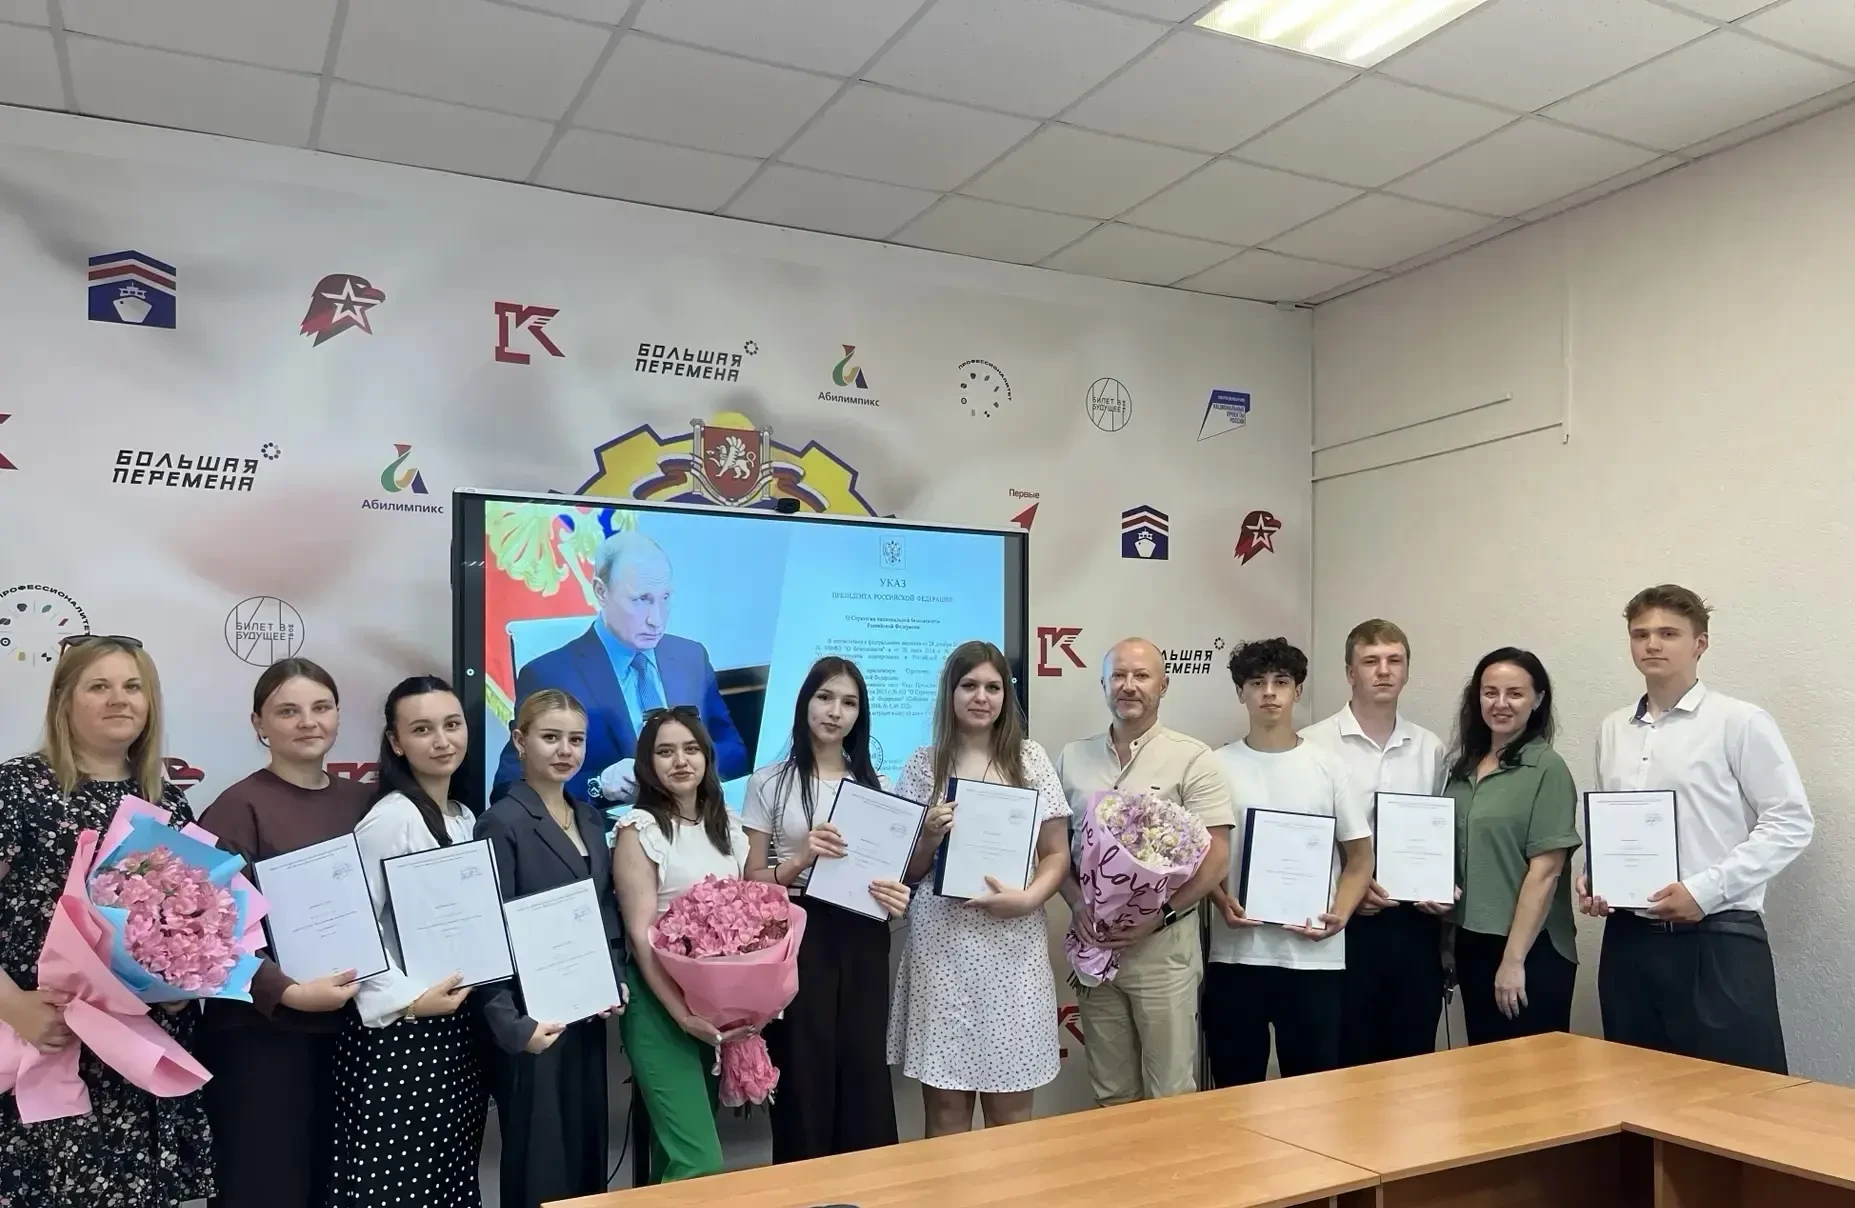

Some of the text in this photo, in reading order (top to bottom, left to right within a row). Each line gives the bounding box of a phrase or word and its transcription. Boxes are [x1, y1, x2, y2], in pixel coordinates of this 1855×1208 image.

[638, 343, 742, 367] БОЛЬШАЯ
[635, 358, 739, 382] ПЕРЕМЕНА
[818, 391, 880, 407] Абилимпикс
[115, 450, 259, 474] БОЛЬШАЯ
[112, 468, 254, 491] ПЕРЕМЕНА
[1009, 488, 1040, 499] Первые
[361, 499, 444, 514] Абилимпикс
[879, 578, 907, 588] УКАЗ
[236, 622, 286, 632] БИЛЕТ В
[236, 631, 286, 641] БУДУЩЕЕ
[1161, 649, 1213, 661] ЛЬШАЯ
[1164, 662, 1211, 674] ЕМЕНА
